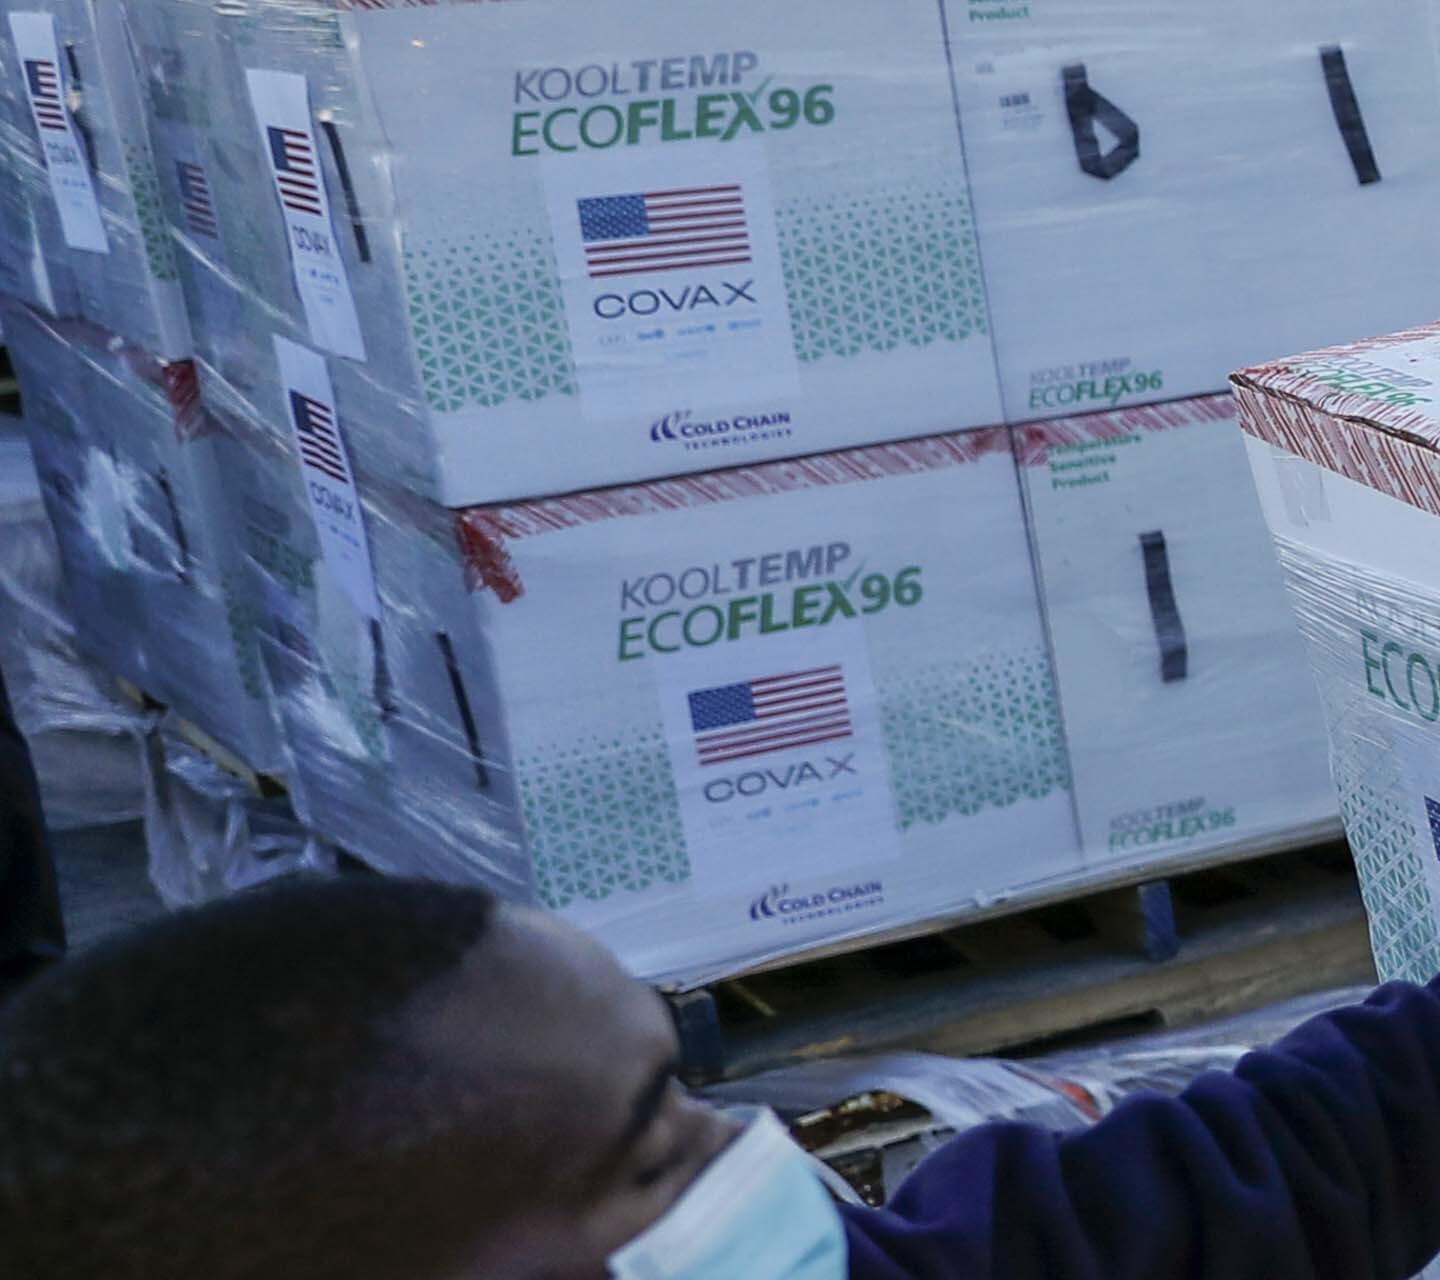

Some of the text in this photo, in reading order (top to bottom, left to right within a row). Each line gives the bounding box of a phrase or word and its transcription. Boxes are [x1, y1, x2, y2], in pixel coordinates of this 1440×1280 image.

[511, 50, 760, 106] KOOLTEMP
[510, 76, 837, 157] ECOFLEX96
[593, 278, 760, 320] COVAX
[680, 410, 792, 440] COLD CHAIN
[620, 540, 853, 614] KOOLTEMP
[616, 562, 927, 664] ECOFLEX96
[702, 751, 860, 806] COVAX
[779, 878, 884, 917] COLD CHAIN
